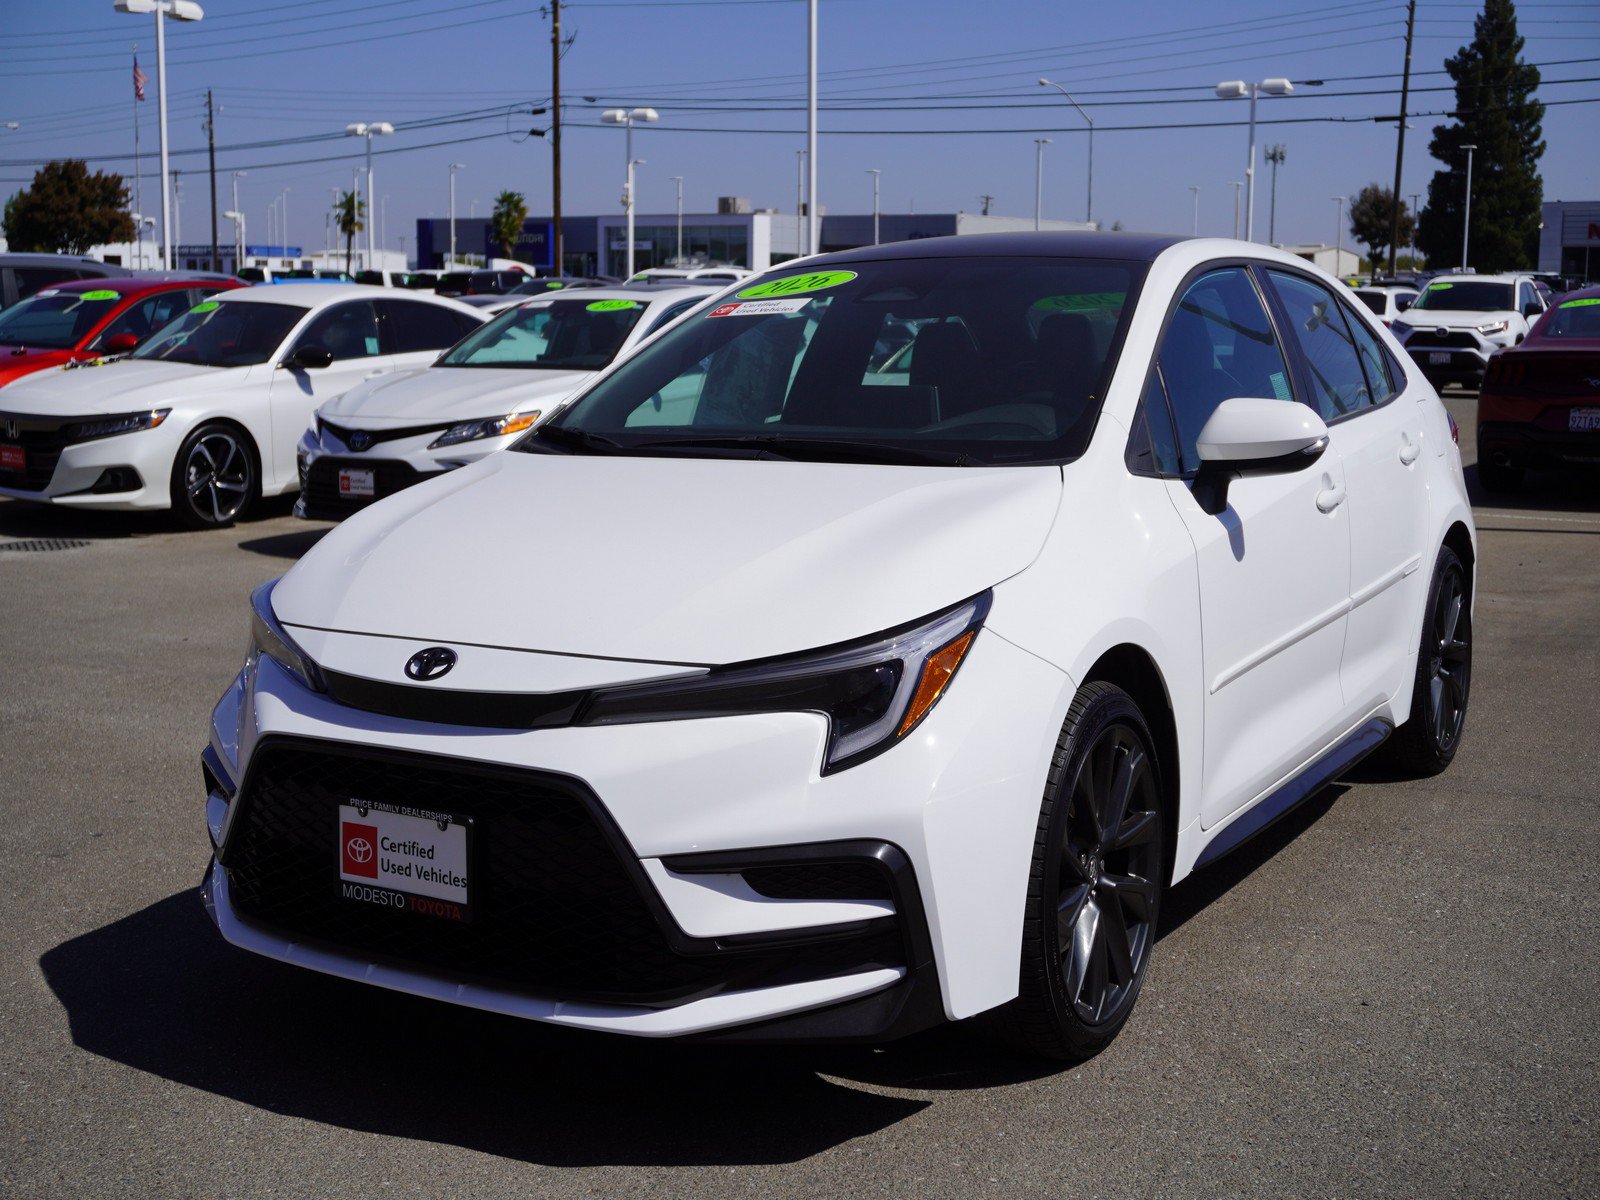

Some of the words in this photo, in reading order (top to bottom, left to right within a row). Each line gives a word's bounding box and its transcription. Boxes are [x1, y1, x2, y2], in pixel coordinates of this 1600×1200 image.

[751, 274, 836, 297] 2026
[350, 798, 372, 809] PRICE
[374, 802, 400, 813] FAMILY
[401, 806, 453, 824] DEALERSHIPS
[380, 836, 435, 861] Certified
[380, 858, 412, 878] Used
[415, 865, 468, 889] Vehicles
[342, 883, 405, 909] MODESTO
[409, 895, 461, 921] TOYOTA
